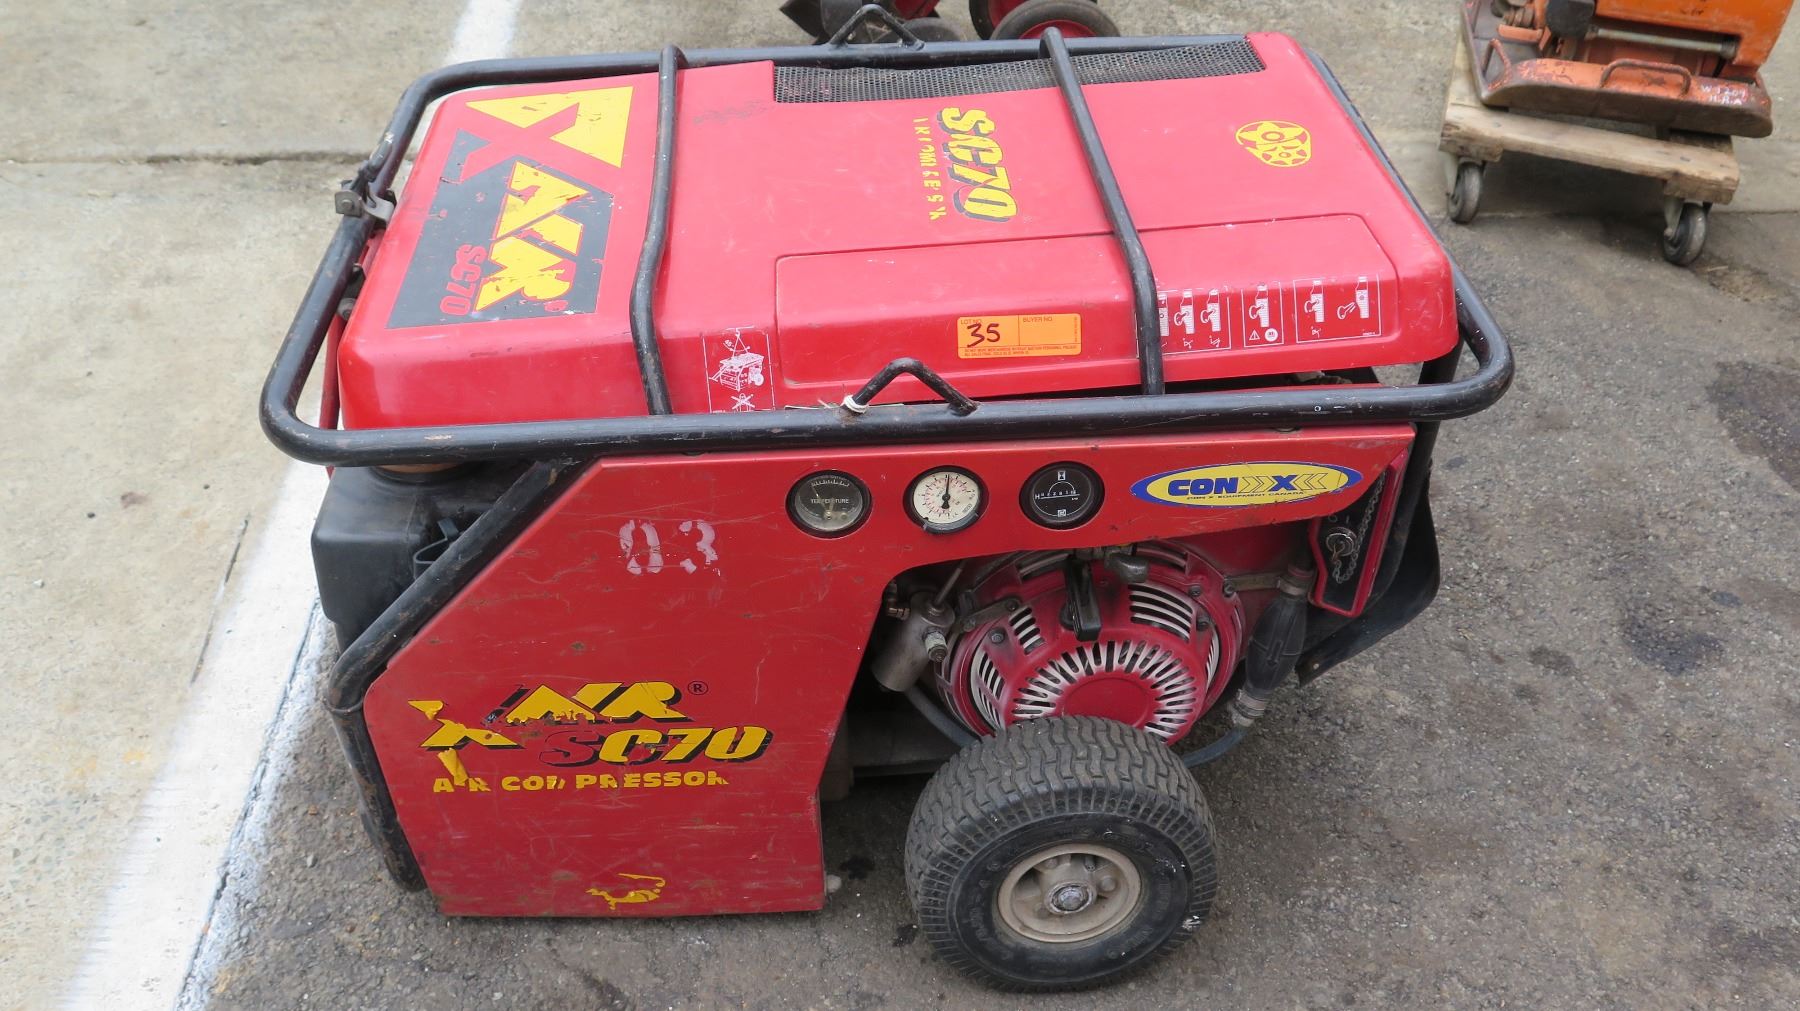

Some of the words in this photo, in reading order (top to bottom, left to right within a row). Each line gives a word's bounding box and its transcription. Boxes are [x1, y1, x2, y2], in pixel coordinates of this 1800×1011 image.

[937, 107, 1018, 222] SC70
[439, 244, 487, 316] SC70
[966, 322, 1001, 348] 35
[1168, 477, 1238, 496] CON
[1268, 475, 1298, 492] X
[433, 777, 492, 793] AR
